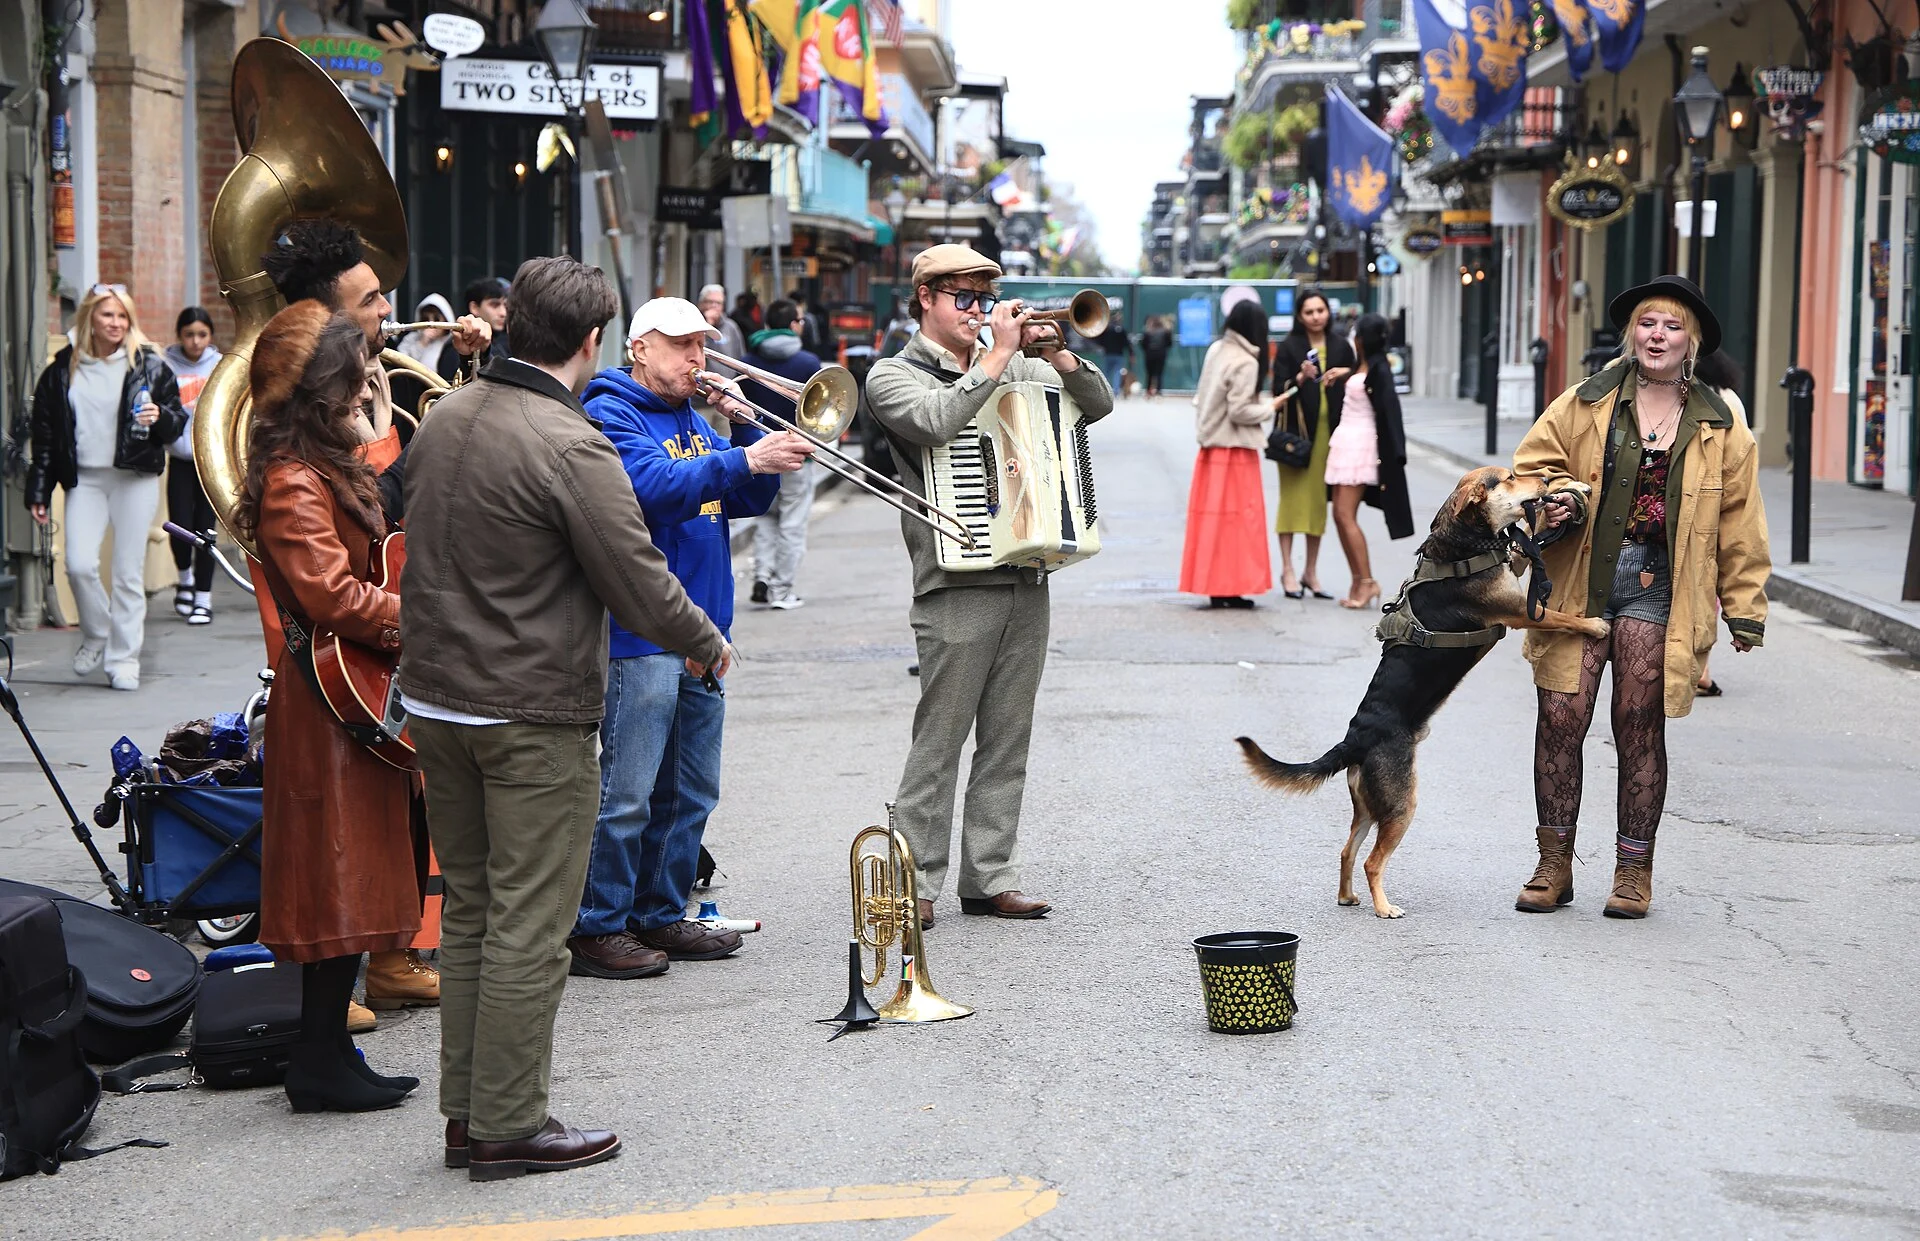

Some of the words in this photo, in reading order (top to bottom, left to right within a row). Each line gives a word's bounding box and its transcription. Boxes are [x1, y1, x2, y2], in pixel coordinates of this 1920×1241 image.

[299, 39, 382, 61] GALLERY
[311, 56, 384, 76] INARD
[528, 64, 597, 81] Cot
[610, 66, 633, 86] of
[452, 81, 515, 101] TWO
[662, 431, 712, 459] BLE
